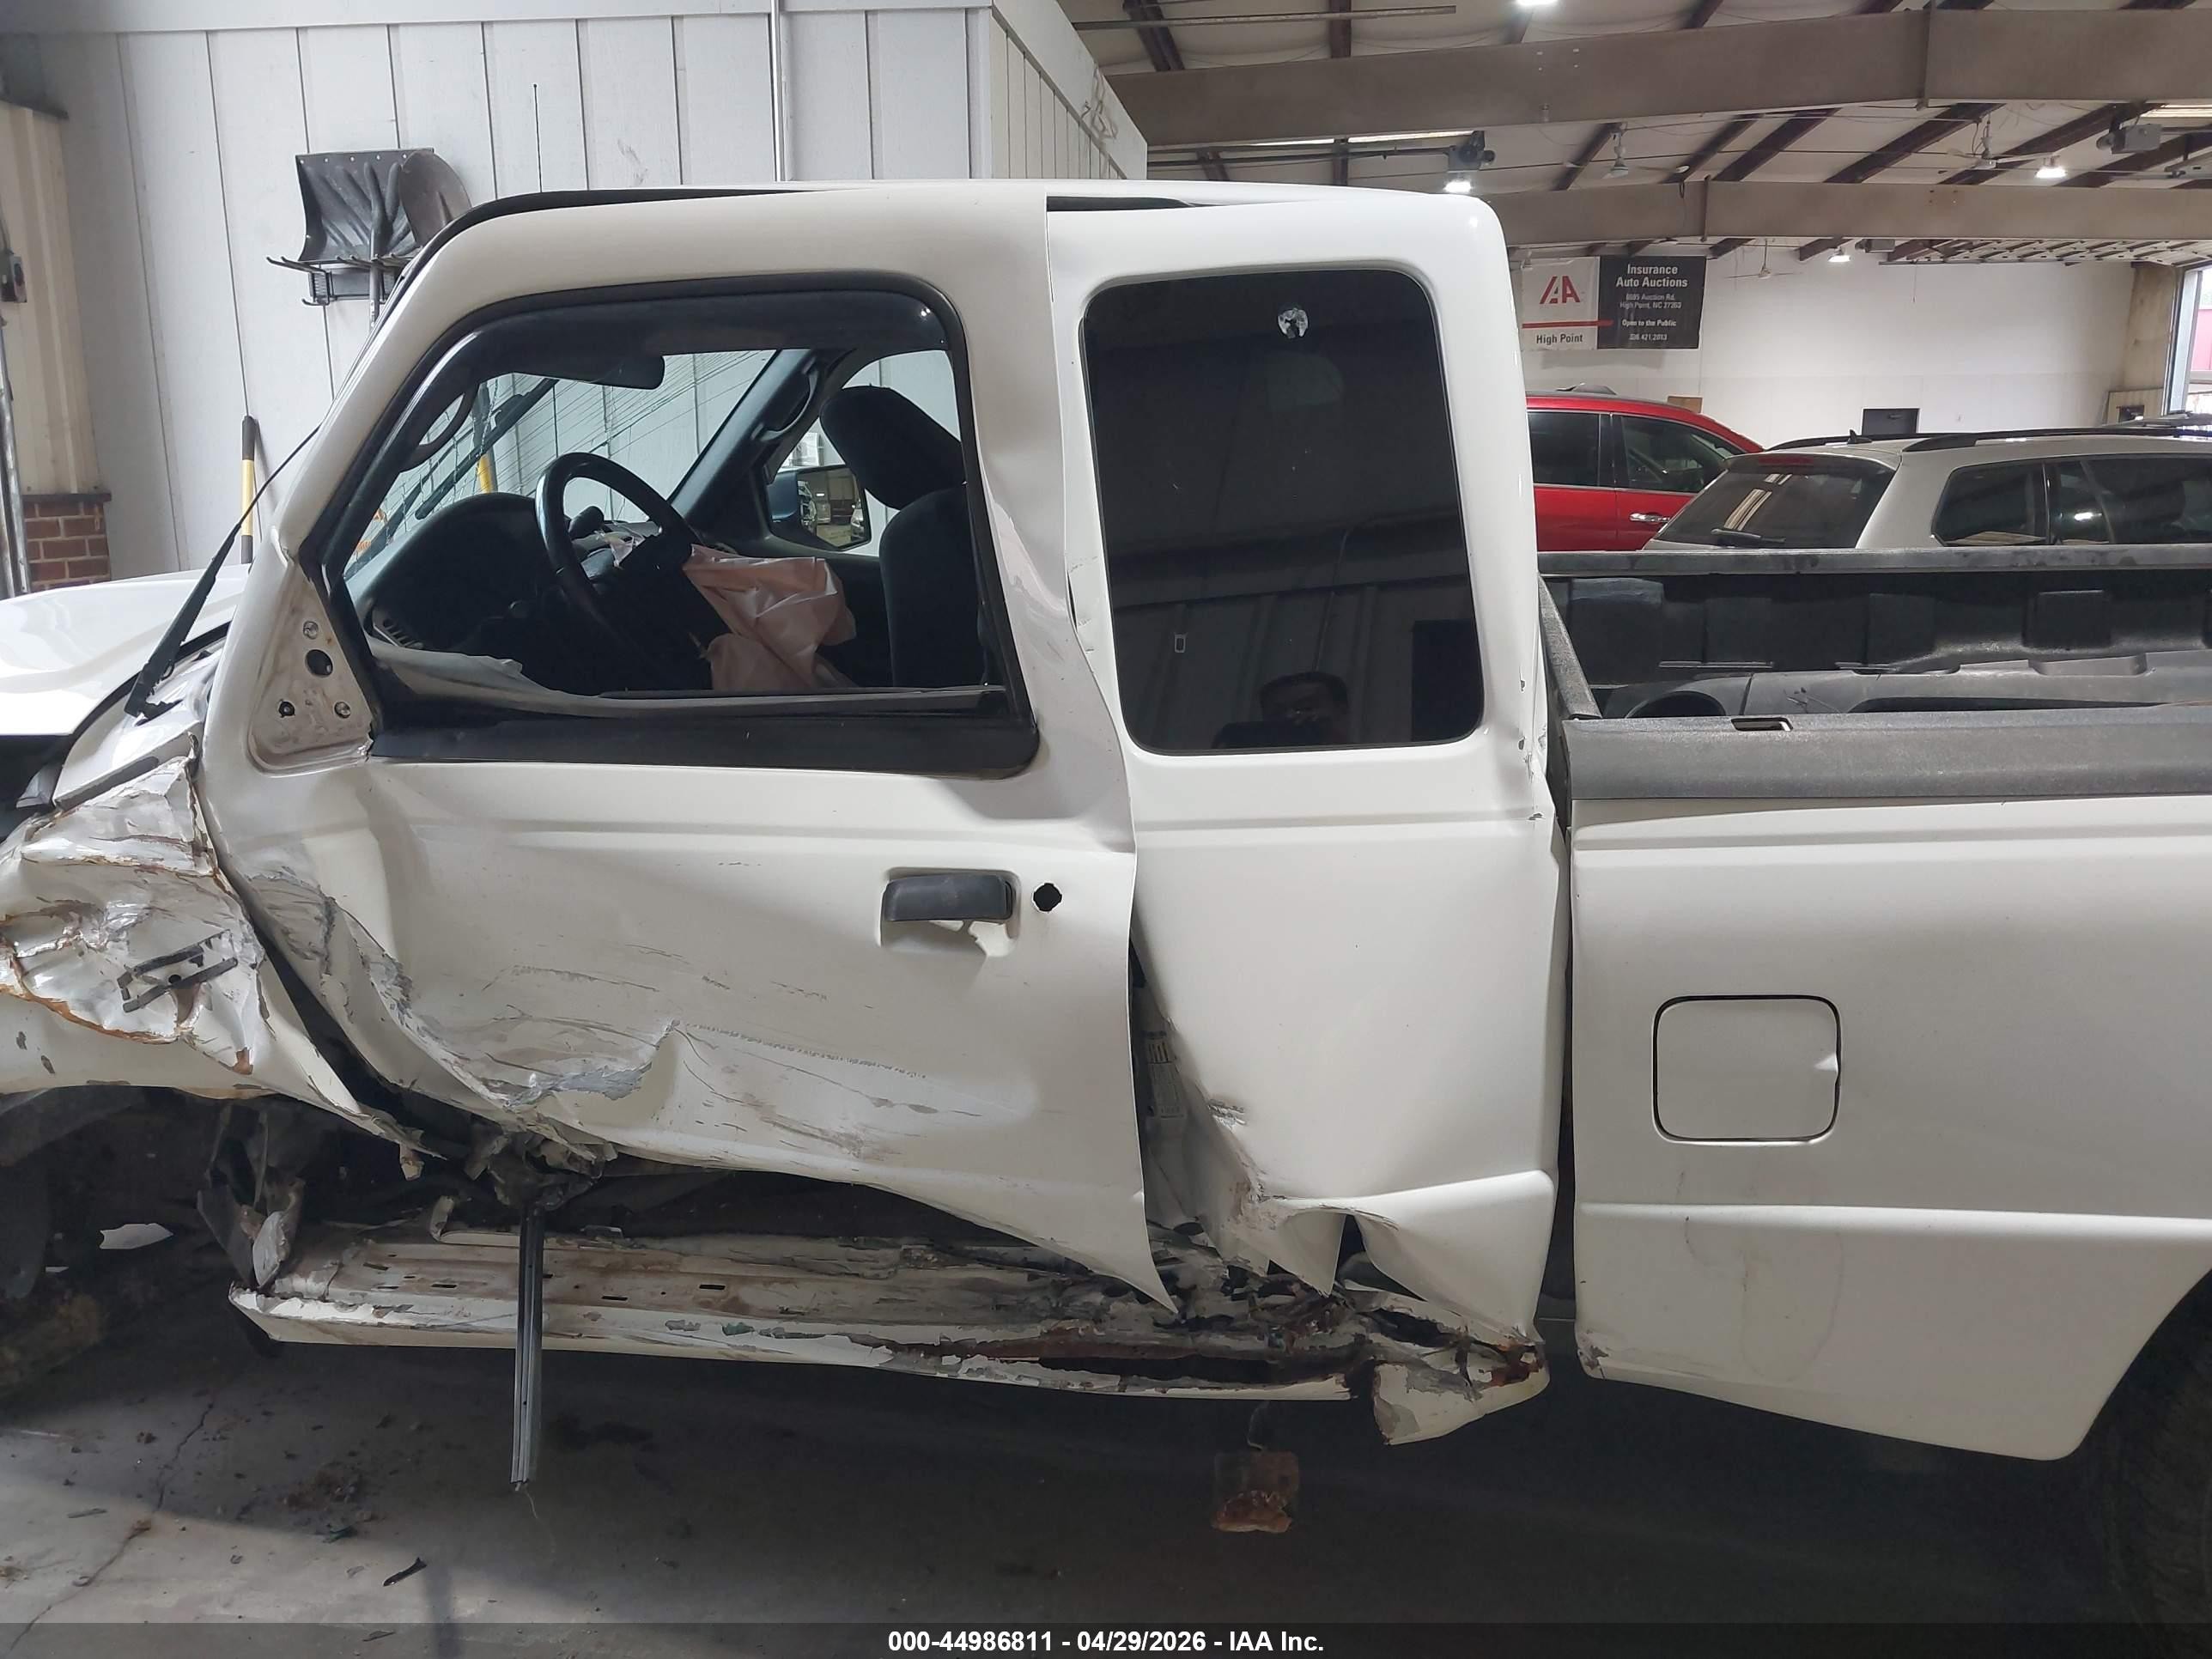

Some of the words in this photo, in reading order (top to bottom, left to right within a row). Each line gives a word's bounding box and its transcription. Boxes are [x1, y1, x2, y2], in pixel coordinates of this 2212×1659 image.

[1626, 264, 1679, 275] Insurance
[1615, 276, 1640, 288] Auto
[1642, 276, 1688, 288] Auctions
[1621, 319, 1638, 327] Open
[1536, 333, 1558, 345] High
[1559, 333, 1583, 343] Point
